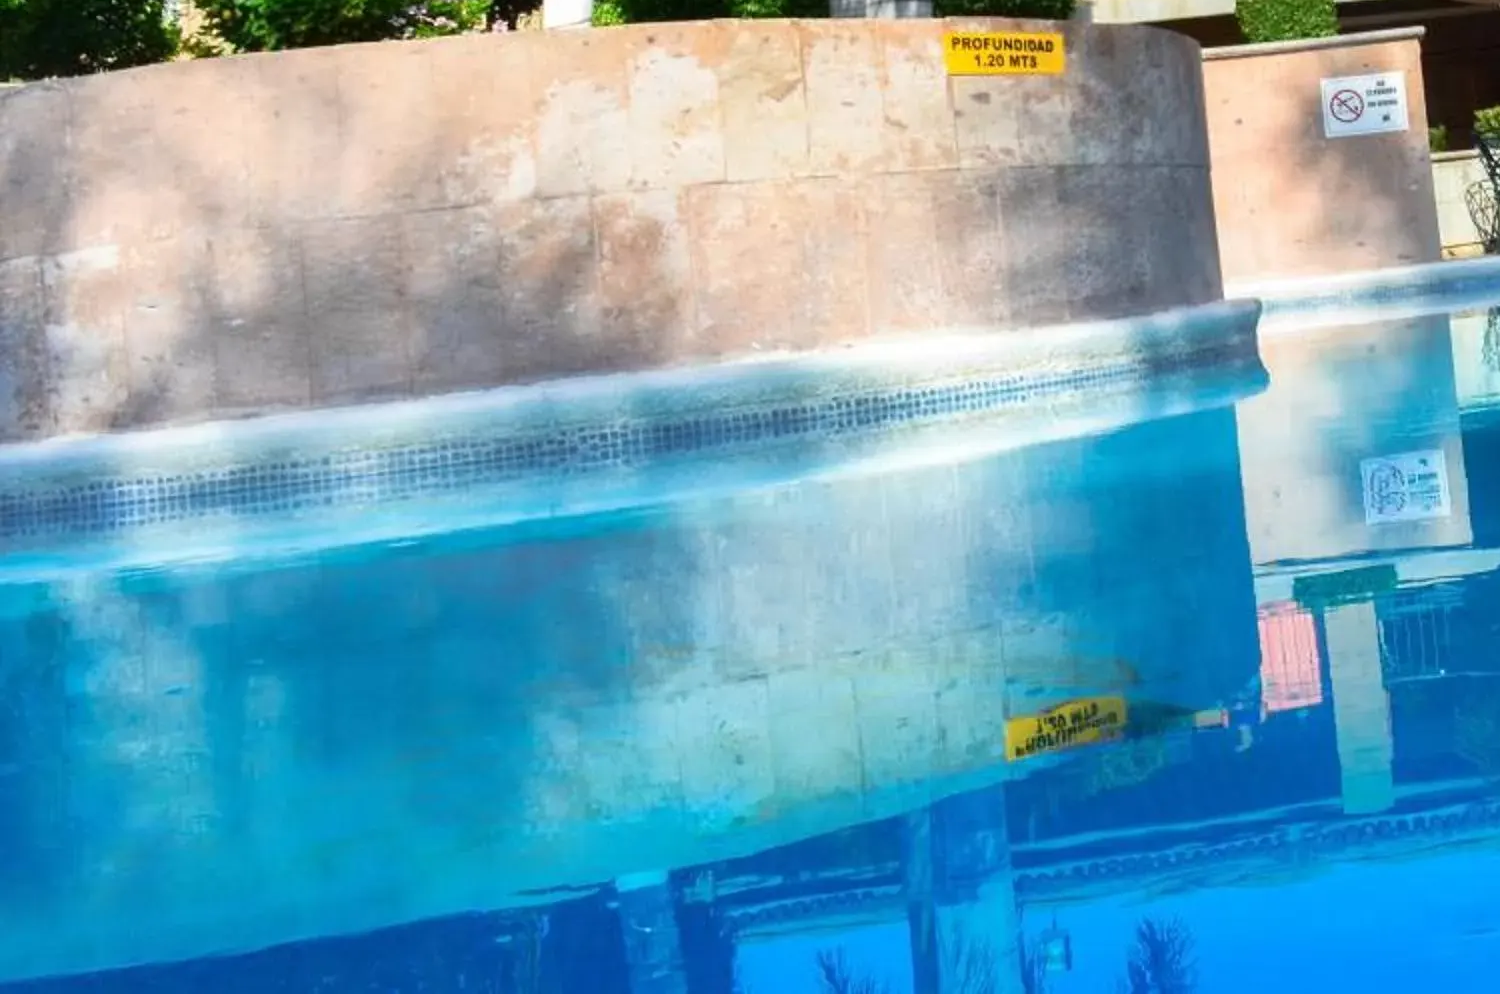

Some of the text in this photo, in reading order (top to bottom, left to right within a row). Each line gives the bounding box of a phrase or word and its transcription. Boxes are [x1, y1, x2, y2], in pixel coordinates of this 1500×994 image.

[951, 37, 1055, 53] PROFUNDIDAD
[974, 54, 1038, 68] 1.20 MTS
